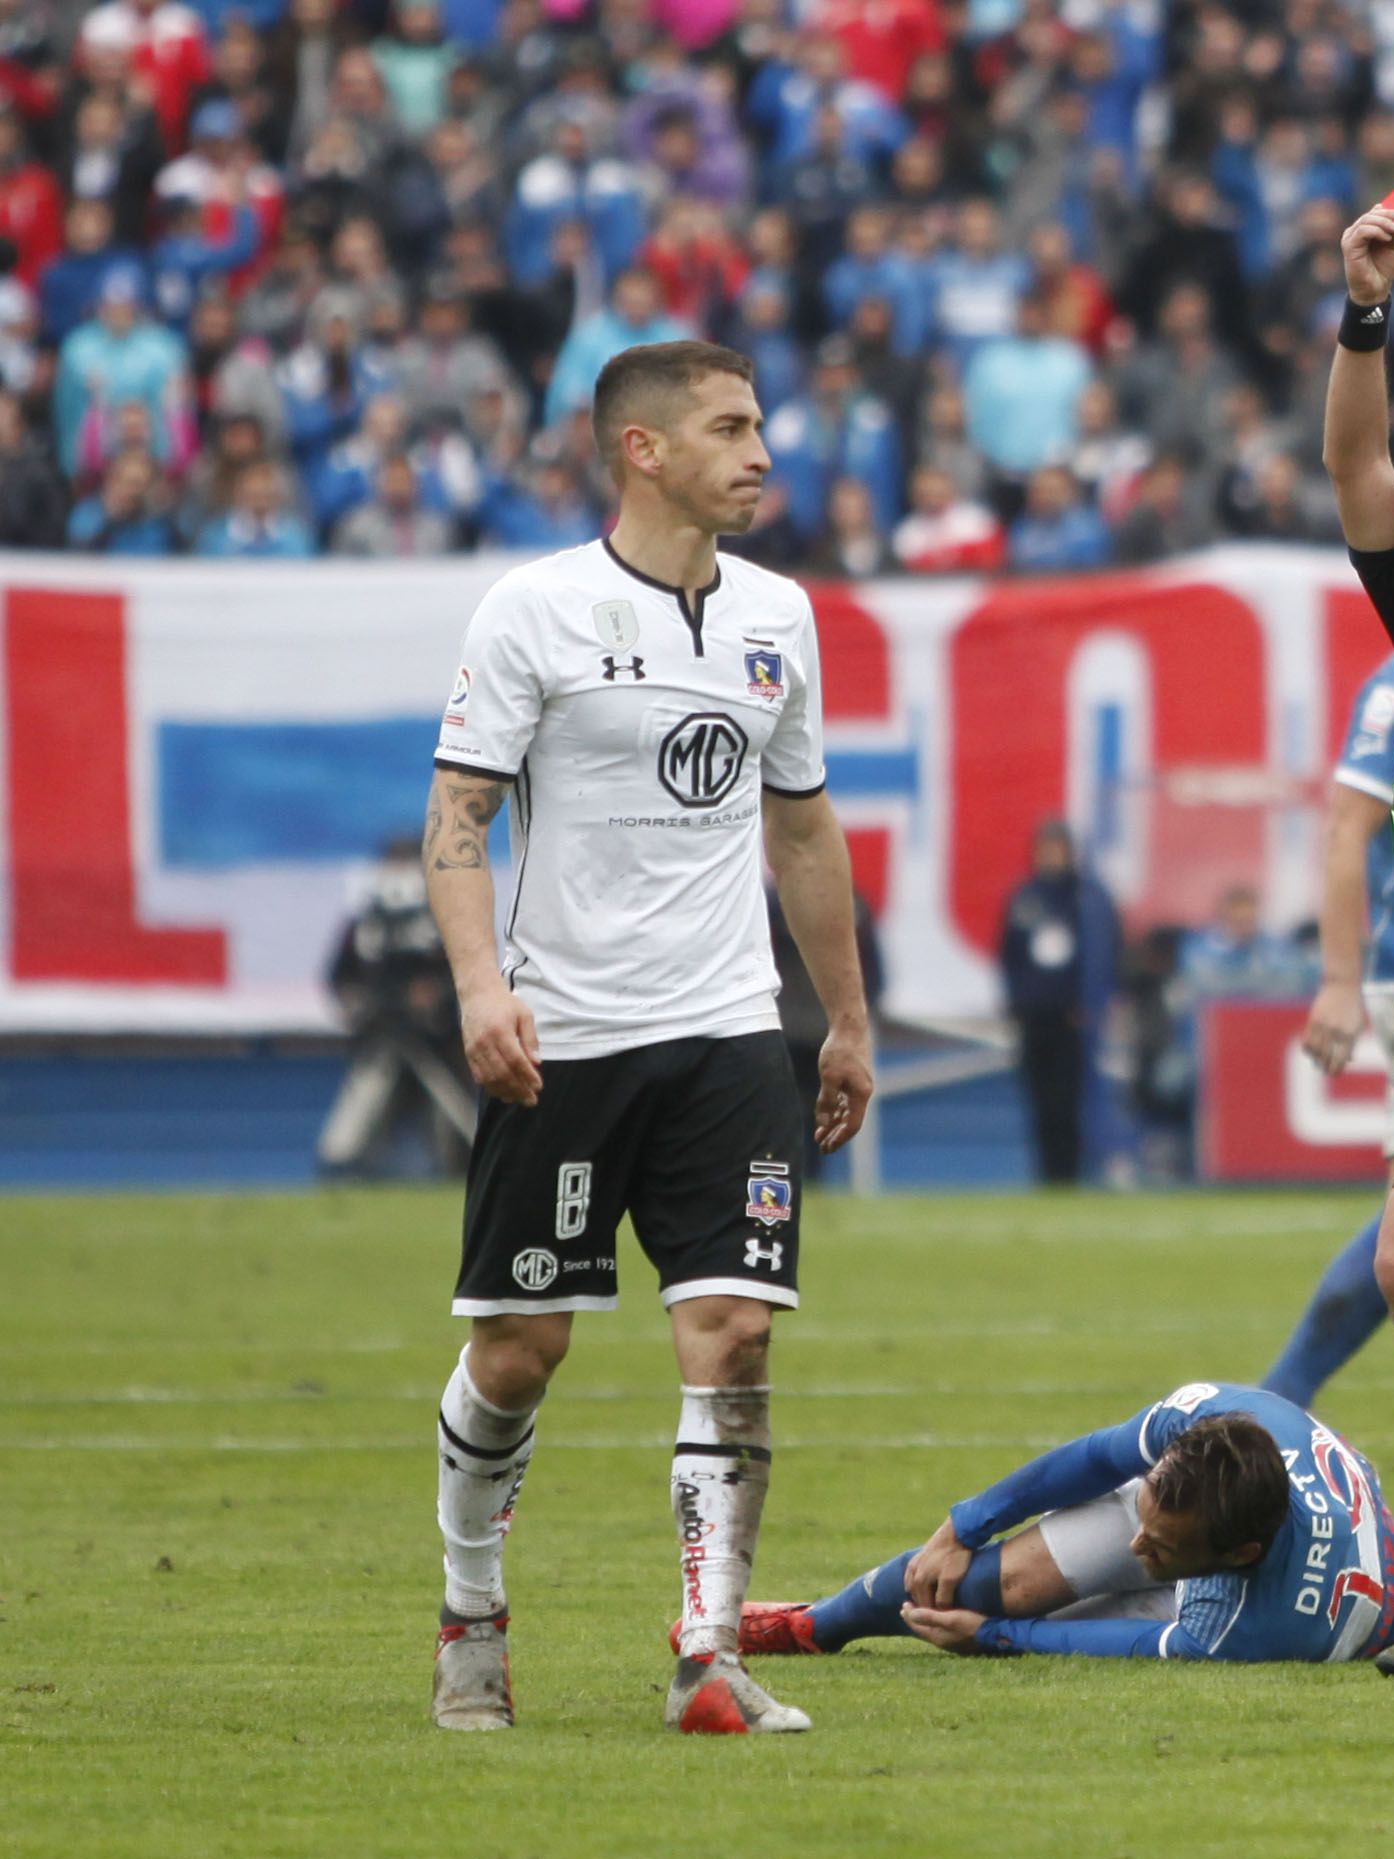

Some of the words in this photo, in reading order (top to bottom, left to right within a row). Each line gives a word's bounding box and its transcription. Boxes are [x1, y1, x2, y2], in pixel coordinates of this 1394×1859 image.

[669, 723, 739, 798] MG
[608, 817, 692, 828] MORRIS
[555, 1162, 593, 1241] 8
[518, 1253, 554, 1286] MG
[562, 1260, 592, 1273] Since
[595, 1257, 616, 1272] 192
[1280, 1447, 1334, 1617] DIRECTV
